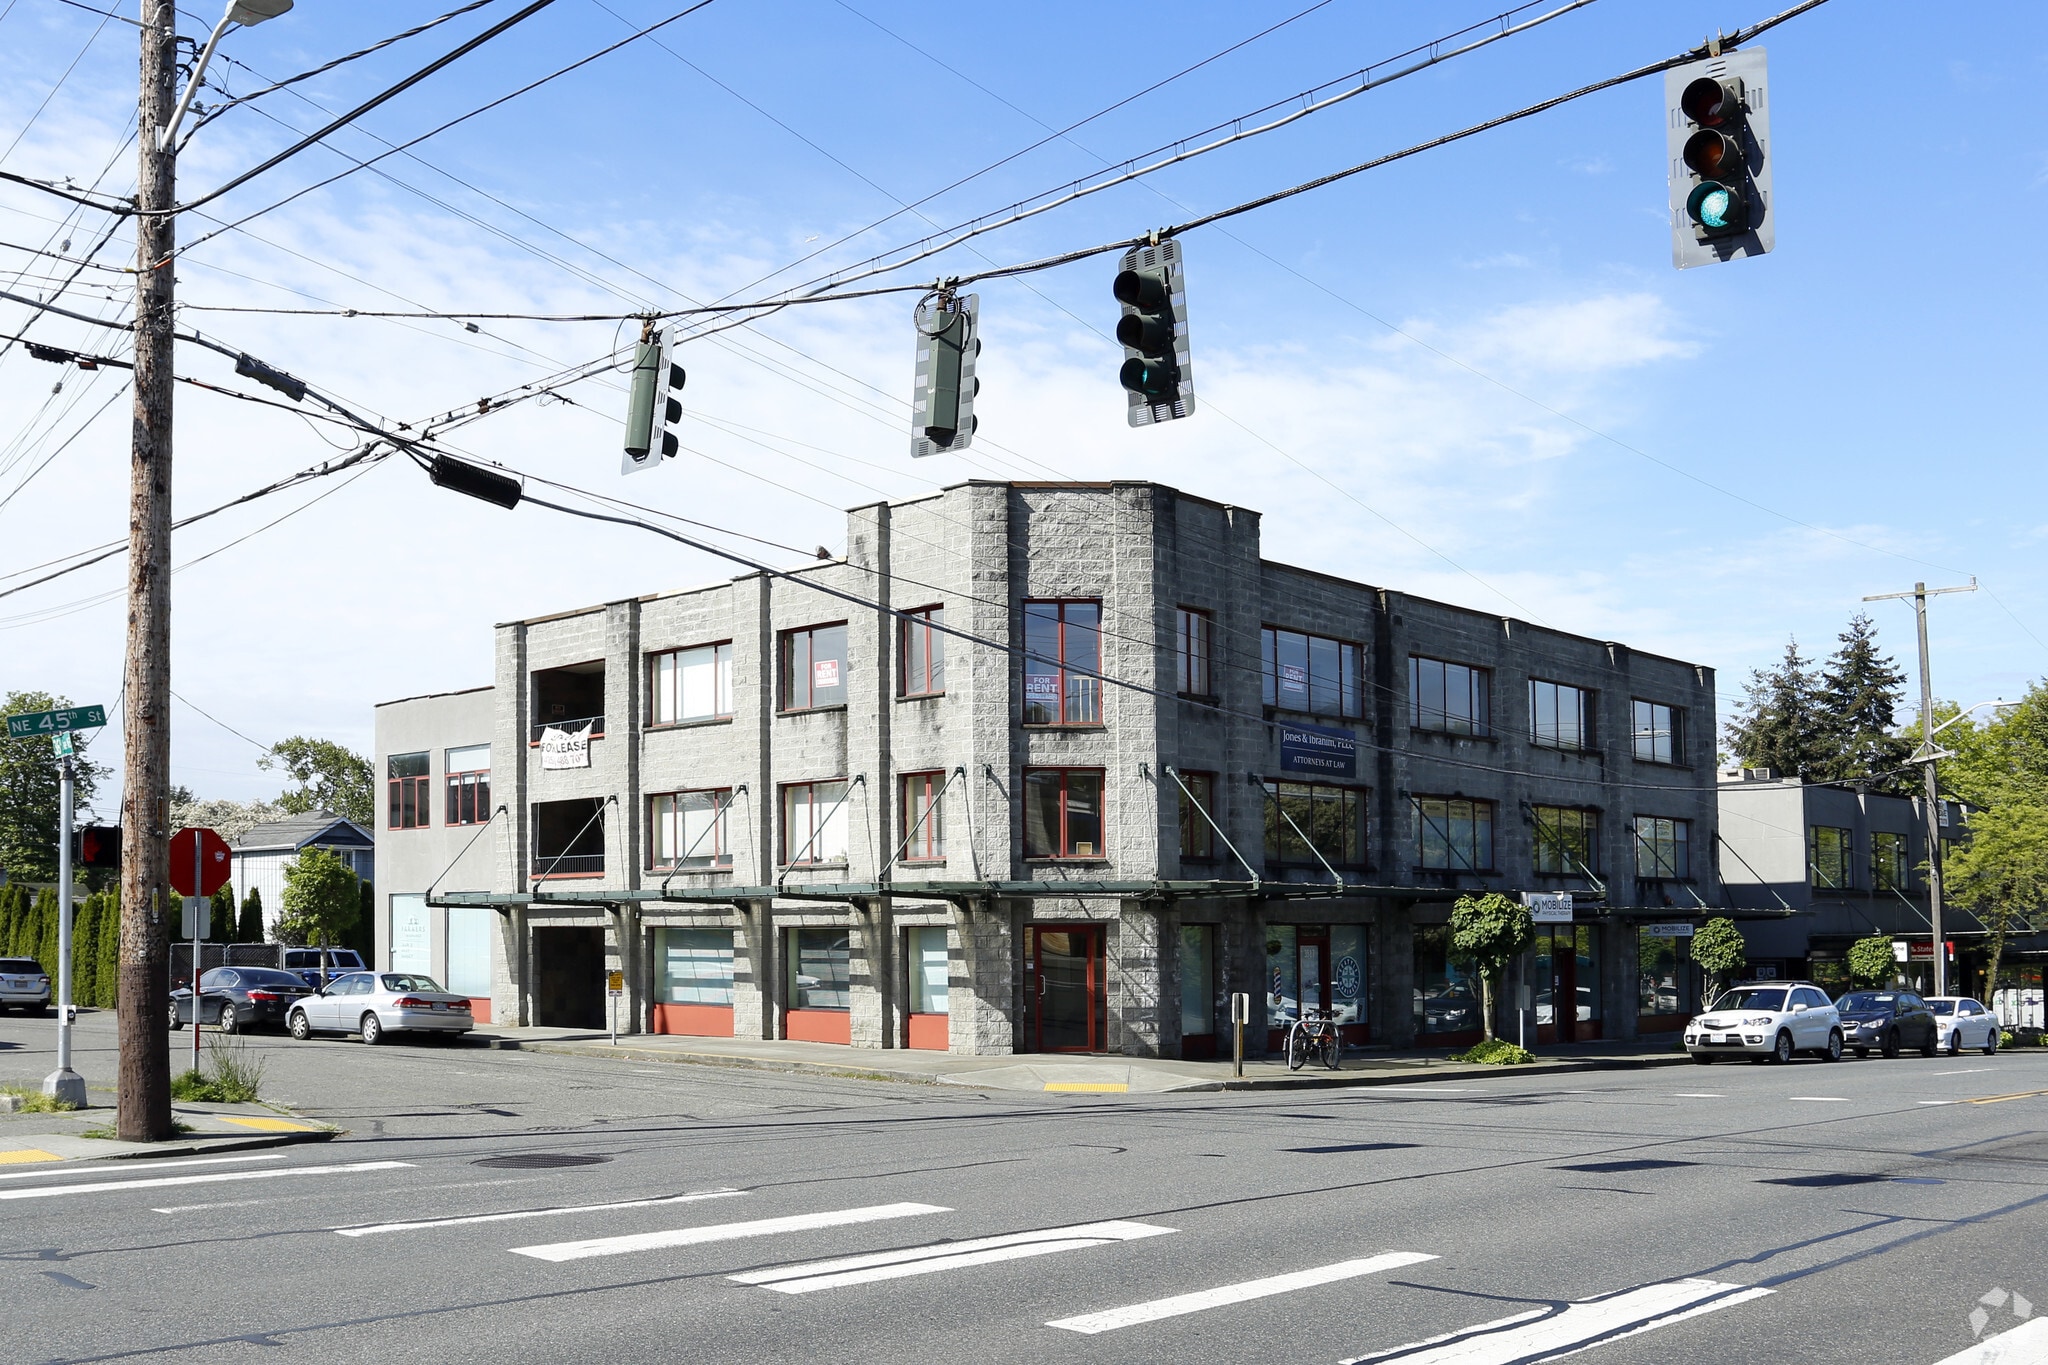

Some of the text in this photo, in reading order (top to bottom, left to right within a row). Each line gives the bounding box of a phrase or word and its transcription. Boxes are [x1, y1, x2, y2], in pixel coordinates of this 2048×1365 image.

[817, 669, 837, 679] RENT
[1026, 683, 1058, 693] RENT
[11, 711, 102, 732] NE 45th St
[1282, 729, 1301, 742] Jones
[1301, 733, 1308, 743] &
[556, 740, 587, 753] LEASE
[1293, 755, 1346, 769] ATTORNEYS AT LAW
[1541, 900, 1572, 910] MOBILIZE
